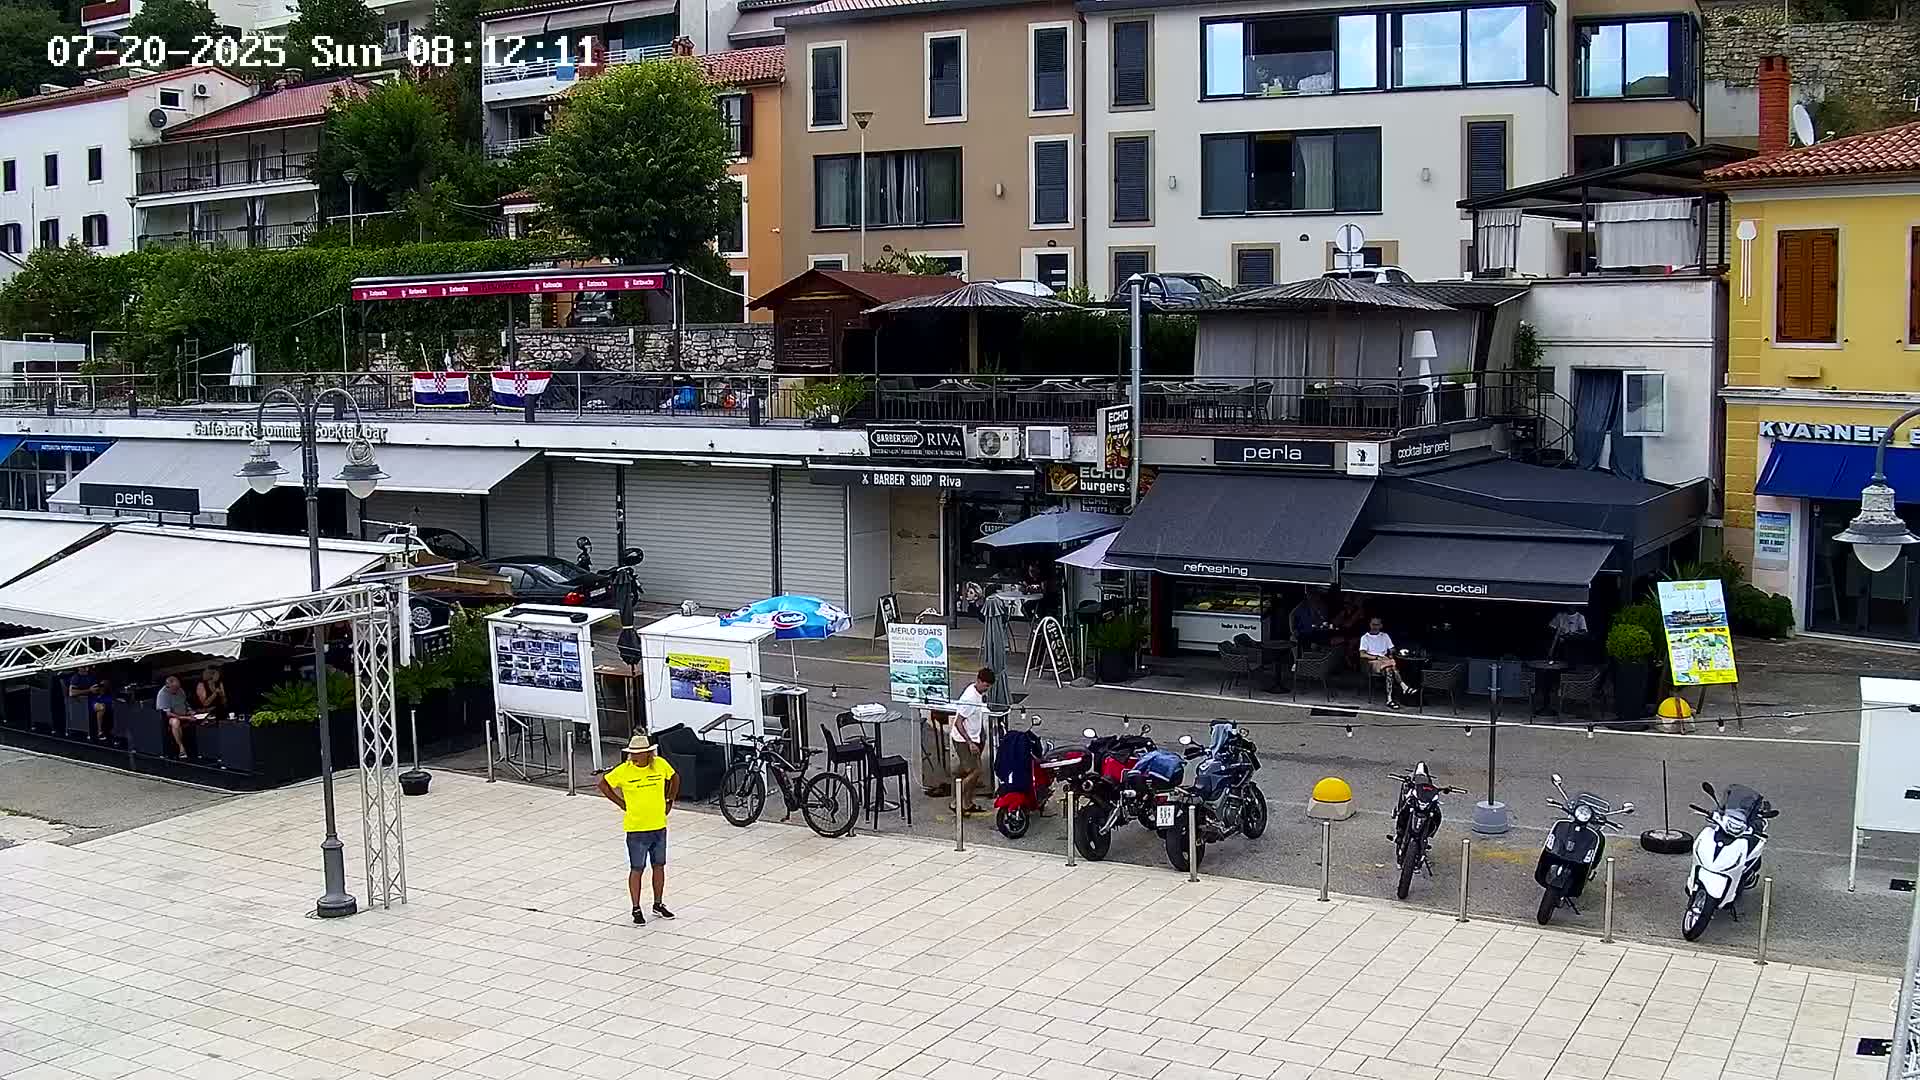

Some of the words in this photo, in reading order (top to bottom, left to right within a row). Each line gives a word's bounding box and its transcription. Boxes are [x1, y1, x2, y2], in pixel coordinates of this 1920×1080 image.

[1108, 410, 1129, 422] ECHO
[363, 425, 388, 440] bar
[1108, 422, 1129, 432] burgers
[927, 433, 961, 446] RIVA
[1243, 444, 1302, 462] perla
[1398, 443, 1422, 459] cocktail
[1423, 442, 1434, 454] bar
[1435, 440, 1450, 455] perla
[1080, 466, 1126, 479] ECHO
[873, 473, 905, 486] BARBER
[910, 474, 933, 487] SHOP
[939, 475, 961, 487] Riva
[1080, 479, 1126, 494] burgers
[115, 490, 154, 506] perla
[1183, 563, 1249, 577] refreshing
[1436, 584, 1488, 594] cocktail
[891, 627, 917, 636] MERLO
